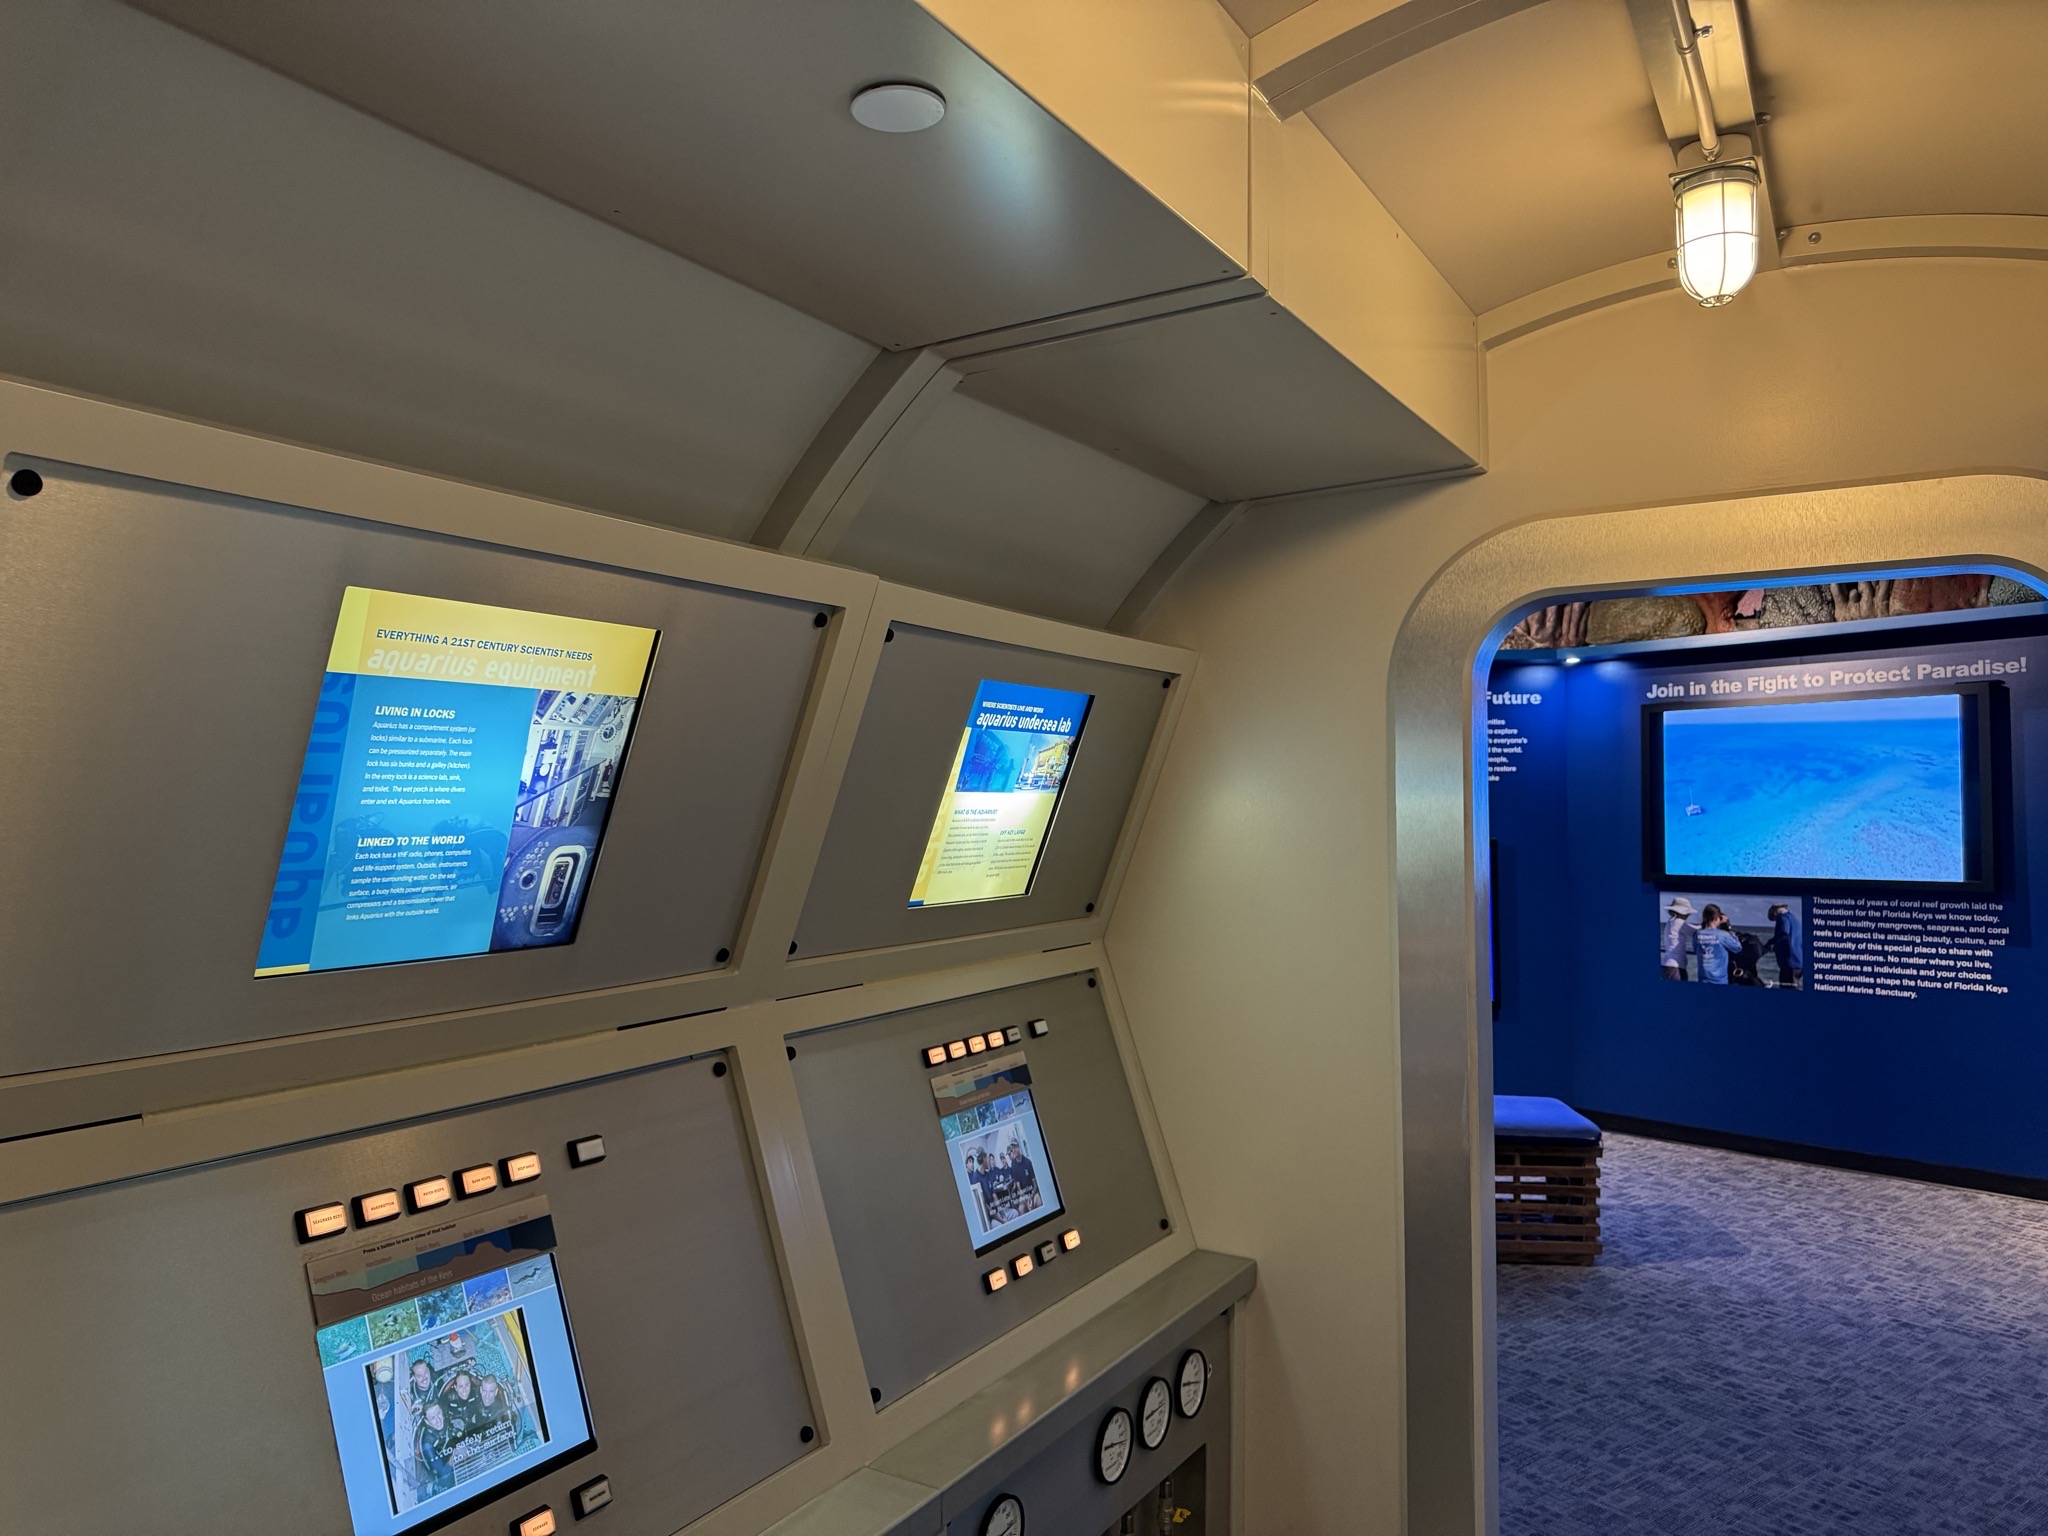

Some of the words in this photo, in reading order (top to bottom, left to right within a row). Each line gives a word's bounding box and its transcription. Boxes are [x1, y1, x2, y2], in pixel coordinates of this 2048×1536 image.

[376, 629, 439, 644] EVERYTHING
[441, 637, 448, 645] A
[451, 638, 475, 647] 21ST
[477, 641, 519, 652] CENTURY
[520, 645, 564, 658] SCIENTIST
[565, 651, 593, 661] NEEDS
[367, 648, 478, 677] aquarius
[484, 658, 597, 688] equipment
[1646, 682, 1684, 699] Join
[1690, 681, 1706, 696] in
[1711, 679, 1742, 694] the
[1747, 674, 1798, 694] Fight
[1803, 673, 1824, 687] to
[1830, 665, 1911, 686] Protect
[1917, 657, 2027, 680] Paradise!
[375, 705, 409, 717] LIVING
[410, 708, 422, 717] IN
[423, 709, 456, 719] LOCKS
[976, 711, 1018, 731] aquarius
[1018, 714, 1058, 732] undersea
[1057, 717, 1072, 733] lab
[1494, 737, 1528, 745] everyone's
[357, 837, 395, 847] LINKED
[396, 837, 409, 846] TO
[411, 836, 430, 845] THE
[431, 835, 465, 845] WORLD
[1813, 896, 1855, 905] Thousands
[1867, 899, 1888, 907] years
[1890, 899, 1898, 907] of
[1900, 900, 1920, 908] coral
[1922, 900, 1938, 908] reef
[1940, 902, 1969, 910] growth
[1972, 902, 1987, 910] laid
[1989, 903, 2003, 911] the
[1813, 907, 1853, 916] foundation
[1855, 909, 1866, 917] for
[1883, 910, 1911, 919] Florida
[1912, 911, 1933, 921] Keys
[1949, 913, 1972, 921] know
[1974, 914, 2000, 924] today.
[1813, 918, 1825, 926] We
[1827, 919, 1846, 927] need
[1847, 920, 1876, 930] healthy
[1878, 922, 1925, 931] mangroves,
[1926, 924, 1967, 933] seagrass,
[1969, 925, 1986, 933] and
[1987, 926, 2010, 934] coral
[1813, 929, 1832, 937] reefs
[1834, 930, 1842, 938] to
[1843, 931, 1871, 939] protect
[1872, 932, 1885, 940] the
[1887, 933, 1921, 943] amazing
[1923, 934, 1952, 945] beauty,
[1954, 937, 1987, 946] culture,
[1988, 938, 2005, 946] and
[1813, 941, 1856, 951] community
[1858, 942, 1867, 950] of
[1867, 943, 1882, 951] this
[1884, 944, 1913, 953] special
[1914, 945, 1937, 954] place
[1949, 947, 1973, 956] share
[1974, 949, 1993, 957] with
[1813, 950, 1836, 959] future
[1838, 953, 1886, 962] generations.
[1887, 955, 1899, 963] No
[1901, 956, 1927, 965] matter
[1929, 958, 1955, 966] where
[1974, 960, 1992, 969] live,
[1813, 962, 1831, 970] your
[1832, 963, 1861, 971] actions
[1874, 965, 1917, 975] individuals
[1919, 969, 1935, 977] and
[1937, 970, 1956, 978] your
[1958, 971, 1992, 980] choices
[1814, 983, 1846, 992] National
[1847, 985, 1874, 994] Marine
[1875, 987, 1918, 999] Sanctuary.
[1825, 974, 1875, 984] communities
[1876, 977, 1901, 986] shape
[1902, 978, 1915, 986] the
[1917, 979, 1942, 988] future
[1943, 981, 1953, 989] of
[1954, 982, 1984, 991] Florida
[1986, 984, 2008, 994] Keys
[372, 1290, 393, 1302] Ocean
[393, 1281, 419, 1294] habitats
[420, 1278, 427, 1286] of
[428, 1274, 438, 1283] the
[439, 1270, 453, 1280] Keys
[455, 1433, 482, 1449] safely
[485, 1420, 512, 1436] return
